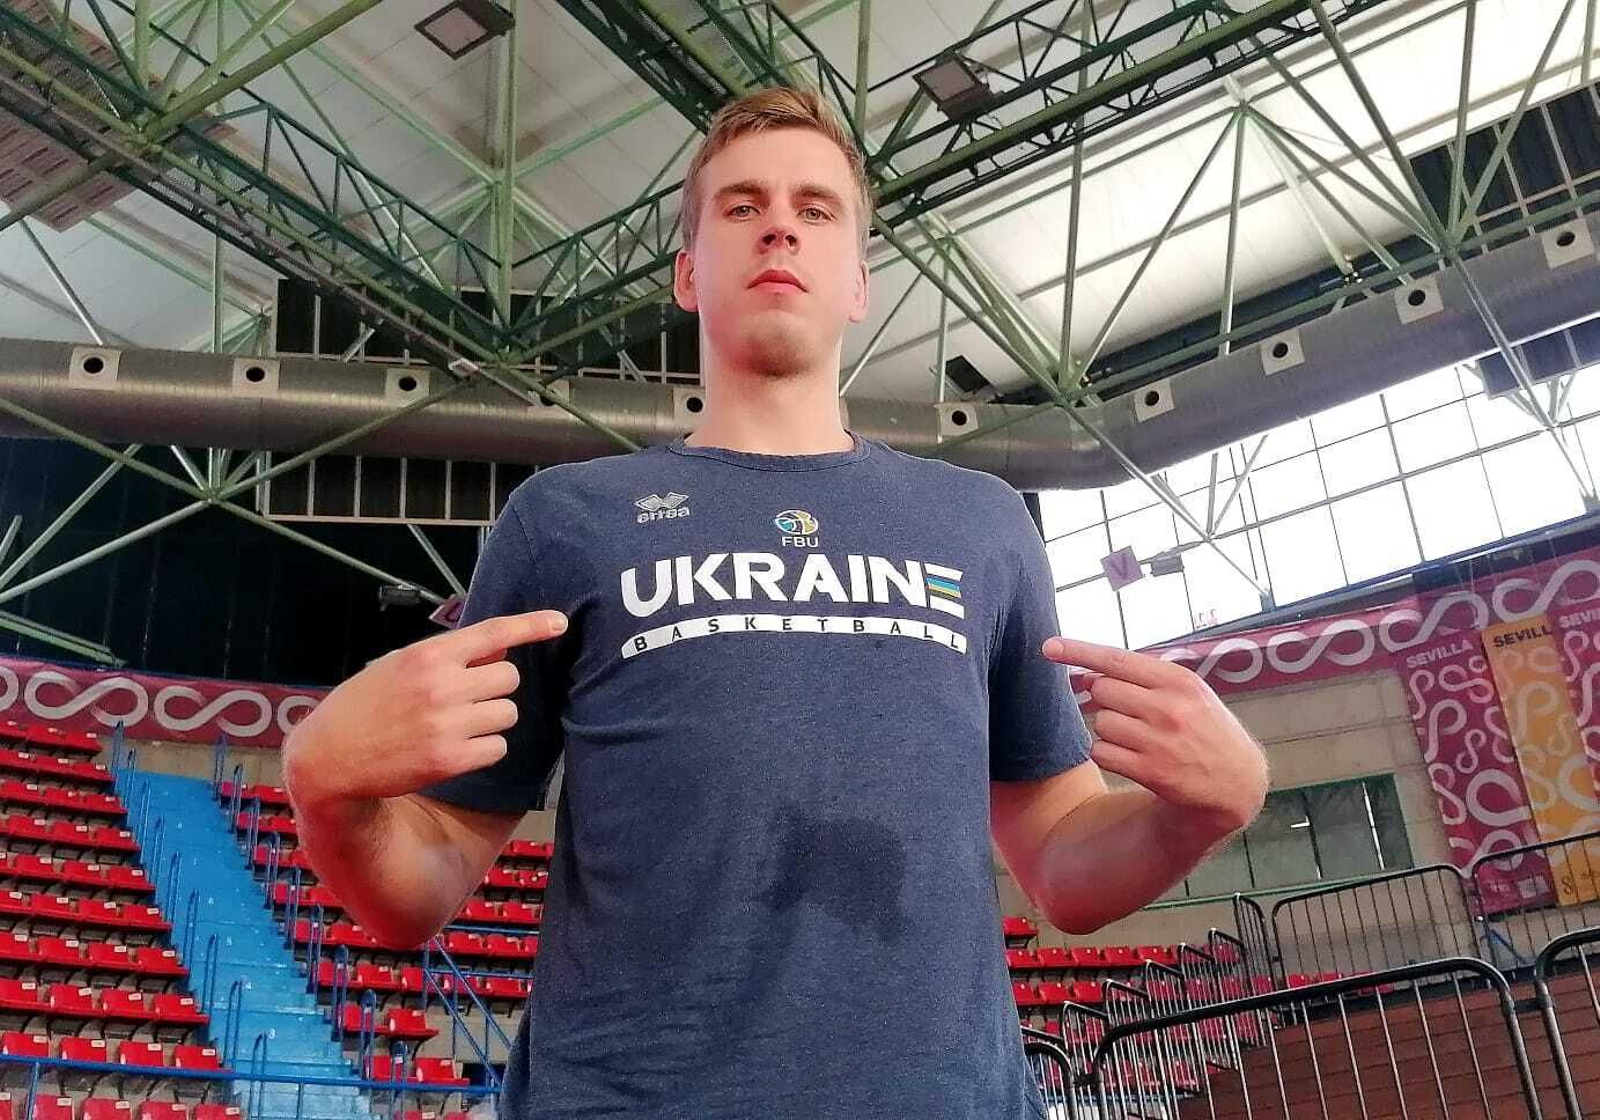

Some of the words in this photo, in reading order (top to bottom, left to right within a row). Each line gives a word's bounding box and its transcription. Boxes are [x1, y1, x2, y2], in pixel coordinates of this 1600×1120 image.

[782, 536, 819, 548] FBU
[620, 552, 965, 619] UKRAINE
[634, 616, 960, 653] BASKETBALL
[1407, 639, 1474, 668] SEVILLA
